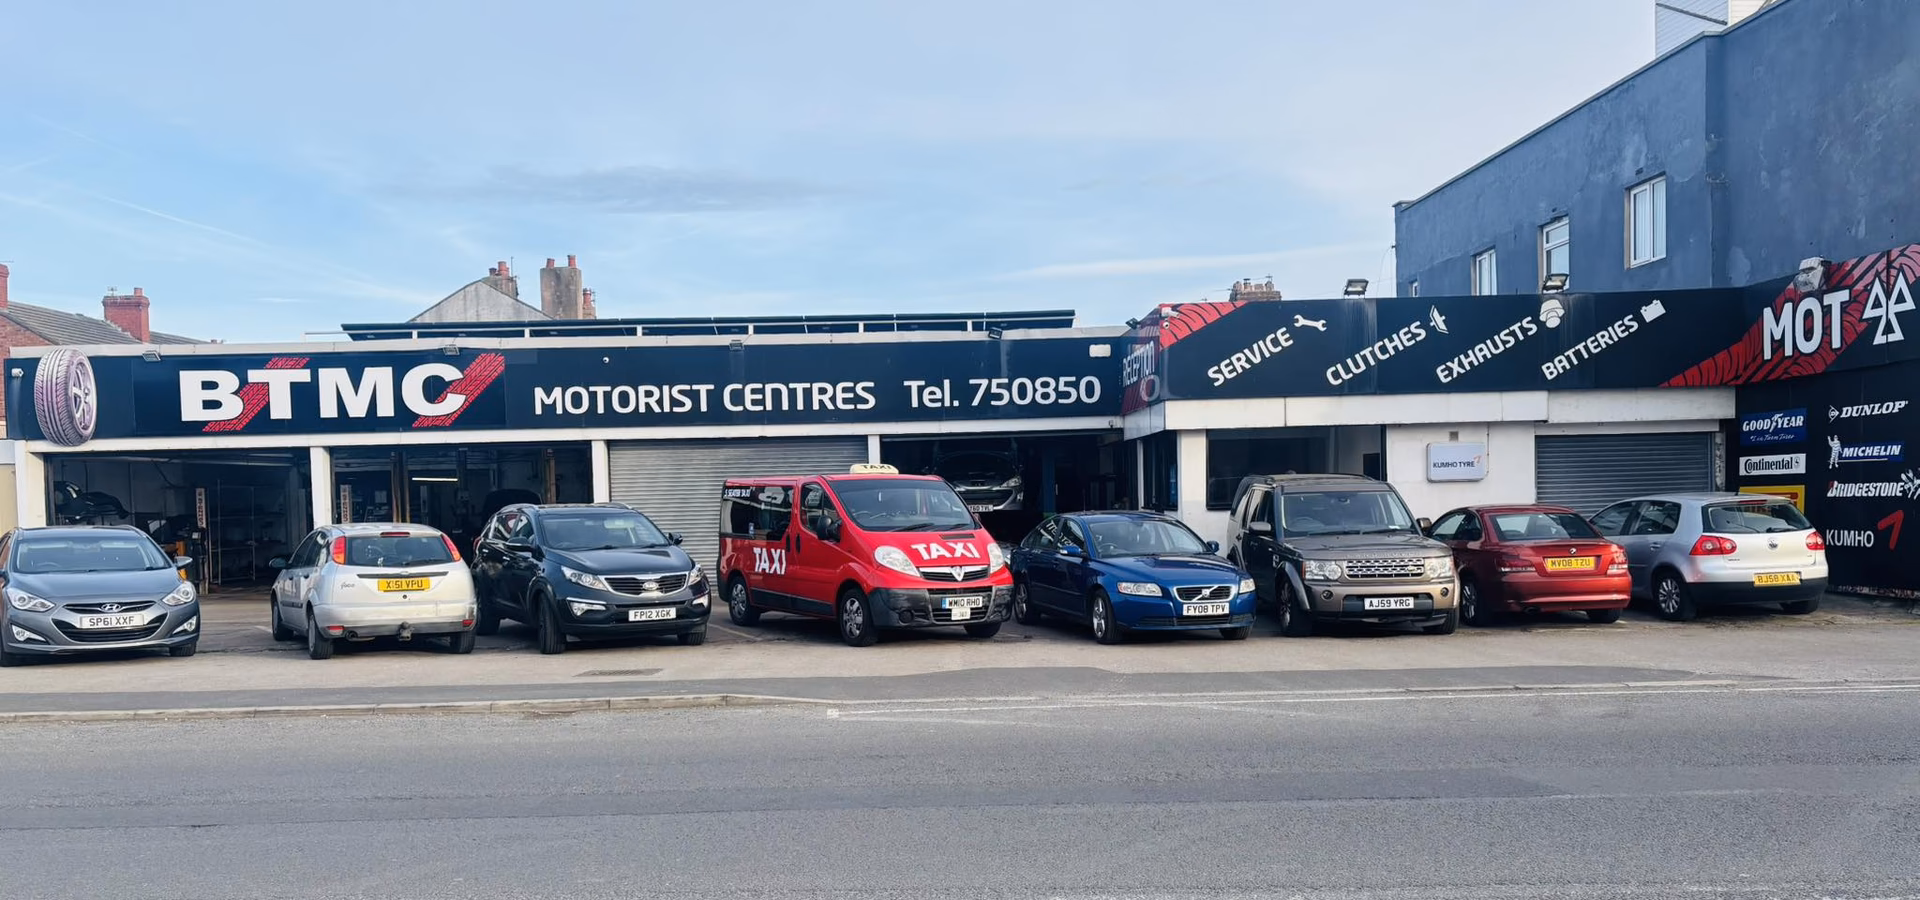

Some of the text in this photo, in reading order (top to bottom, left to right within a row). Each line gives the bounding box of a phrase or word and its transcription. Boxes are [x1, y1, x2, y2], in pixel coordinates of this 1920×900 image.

[1763, 289, 1850, 361] MOT
[1326, 321, 1427, 386] CLUTCHES
[1436, 316, 1538, 384] EXHAUSTS
[1541, 314, 1639, 381] BATTERIES
[1207, 327, 1294, 387] SERVICE
[179, 362, 467, 422] BTMC
[534, 375, 1101, 415] MOTORIST CENTRES Tel. 750850
[1840, 401, 1906, 418] DUNLOP
[1742, 413, 1804, 432] GOODYEAR
[1842, 445, 1902, 458] MICHELIN
[1432, 461, 1458, 469] KUMHO
[1744, 457, 1793, 474] Continental
[1827, 480, 1905, 498] BRIDGESTONE
[1826, 529, 1875, 548] KUMHO
[911, 542, 981, 560] TAXI
[753, 547, 786, 575] TAXI
[404, 579, 423, 588] VPU
[1186, 604, 1226, 614] FY08 TPV
[1369, 599, 1411, 608] AJ59 YRG
[89, 616, 135, 627] SP61 XXF
[633, 610, 671, 619] FP12 XGK
